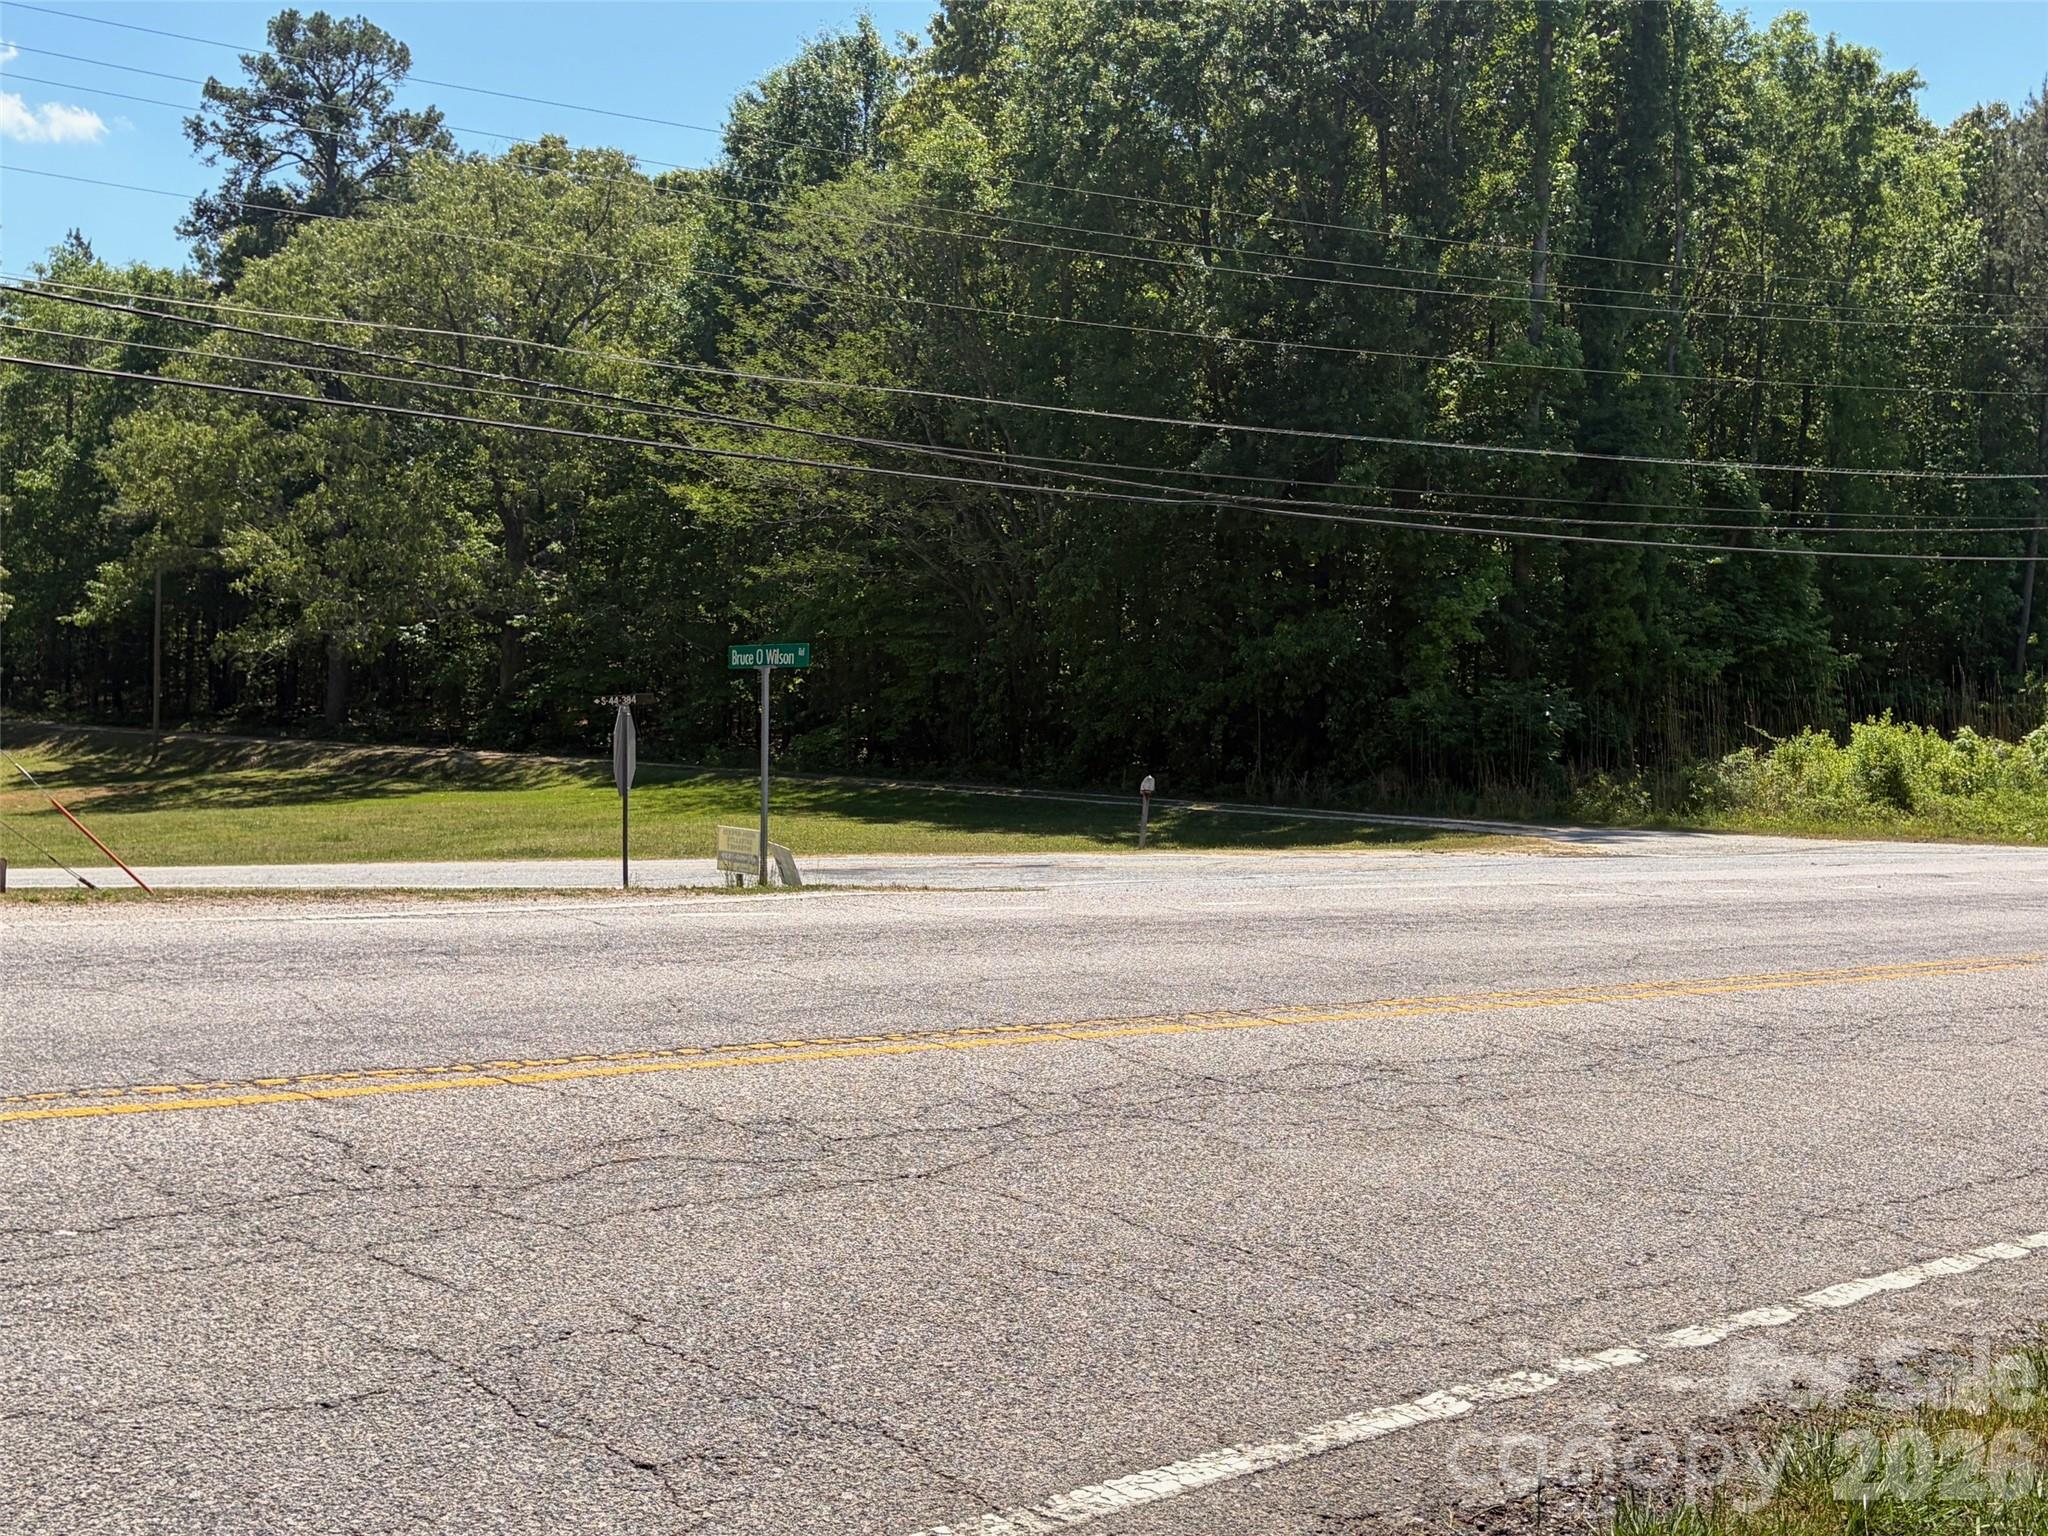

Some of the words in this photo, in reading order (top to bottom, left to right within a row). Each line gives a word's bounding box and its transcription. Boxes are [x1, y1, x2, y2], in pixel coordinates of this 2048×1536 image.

[731, 649, 754, 666] Bruce
[756, 649, 764, 665] O
[766, 648, 795, 665] Wilson
[798, 647, 805, 656] Rd
